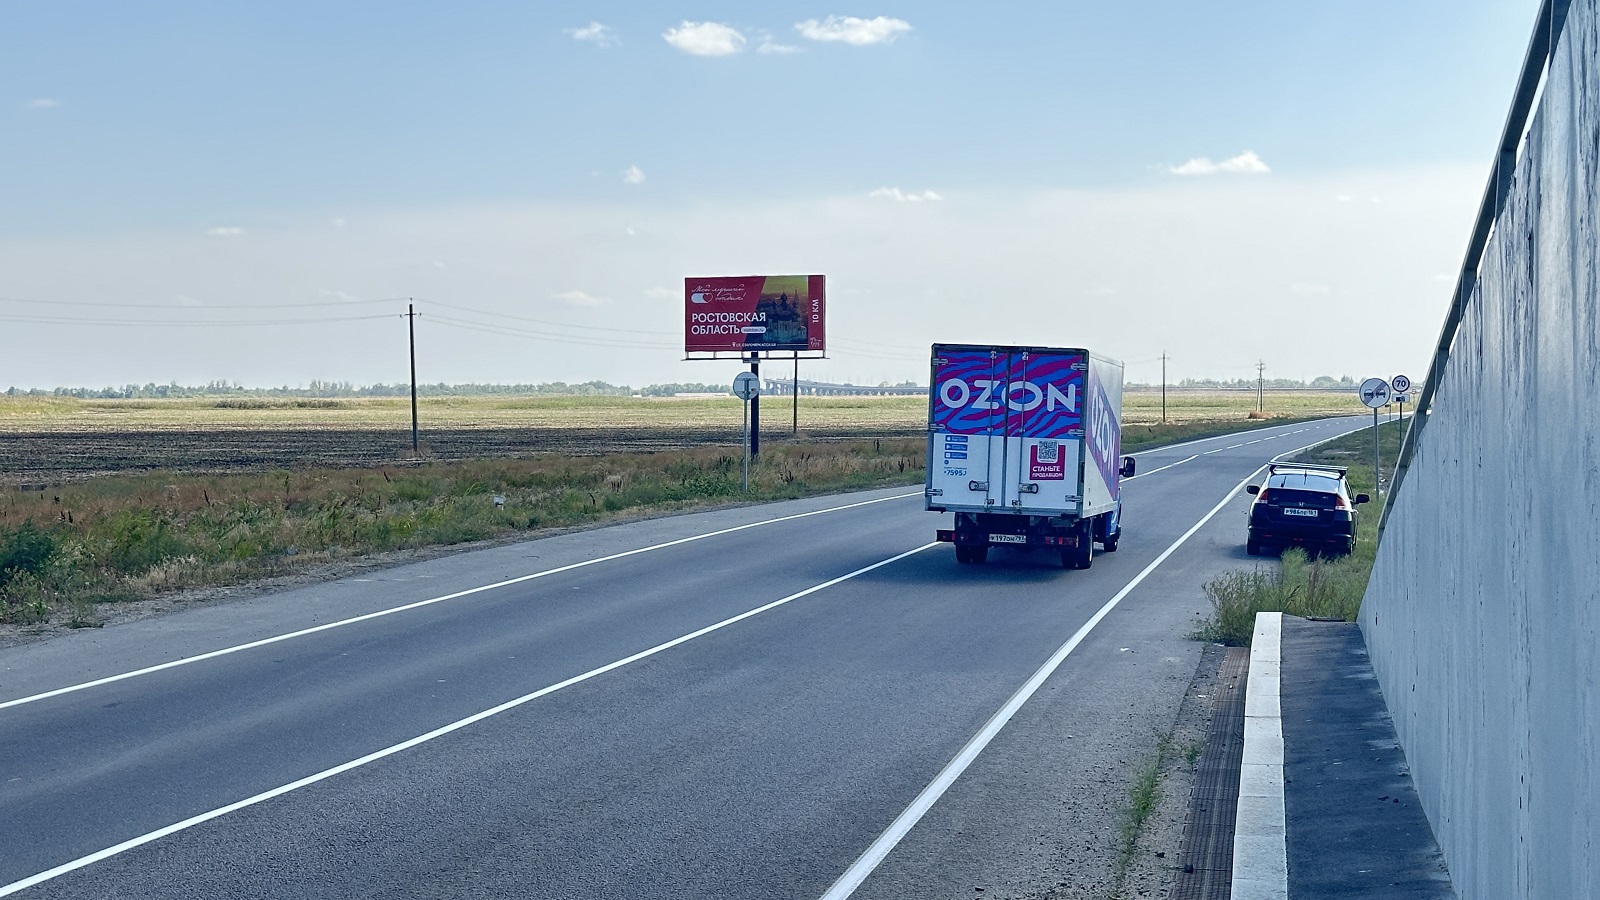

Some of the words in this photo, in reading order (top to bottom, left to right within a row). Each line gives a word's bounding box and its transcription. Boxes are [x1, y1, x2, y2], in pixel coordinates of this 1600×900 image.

[691, 312, 766, 323] РОСТОВСКАЯ
[812, 313, 819, 324] 10
[691, 325, 740, 335] ОБЛАСТЬ
[1395, 380, 1407, 388] 70
[940, 378, 1076, 413] OZON
[1091, 385, 1116, 478] OZON
